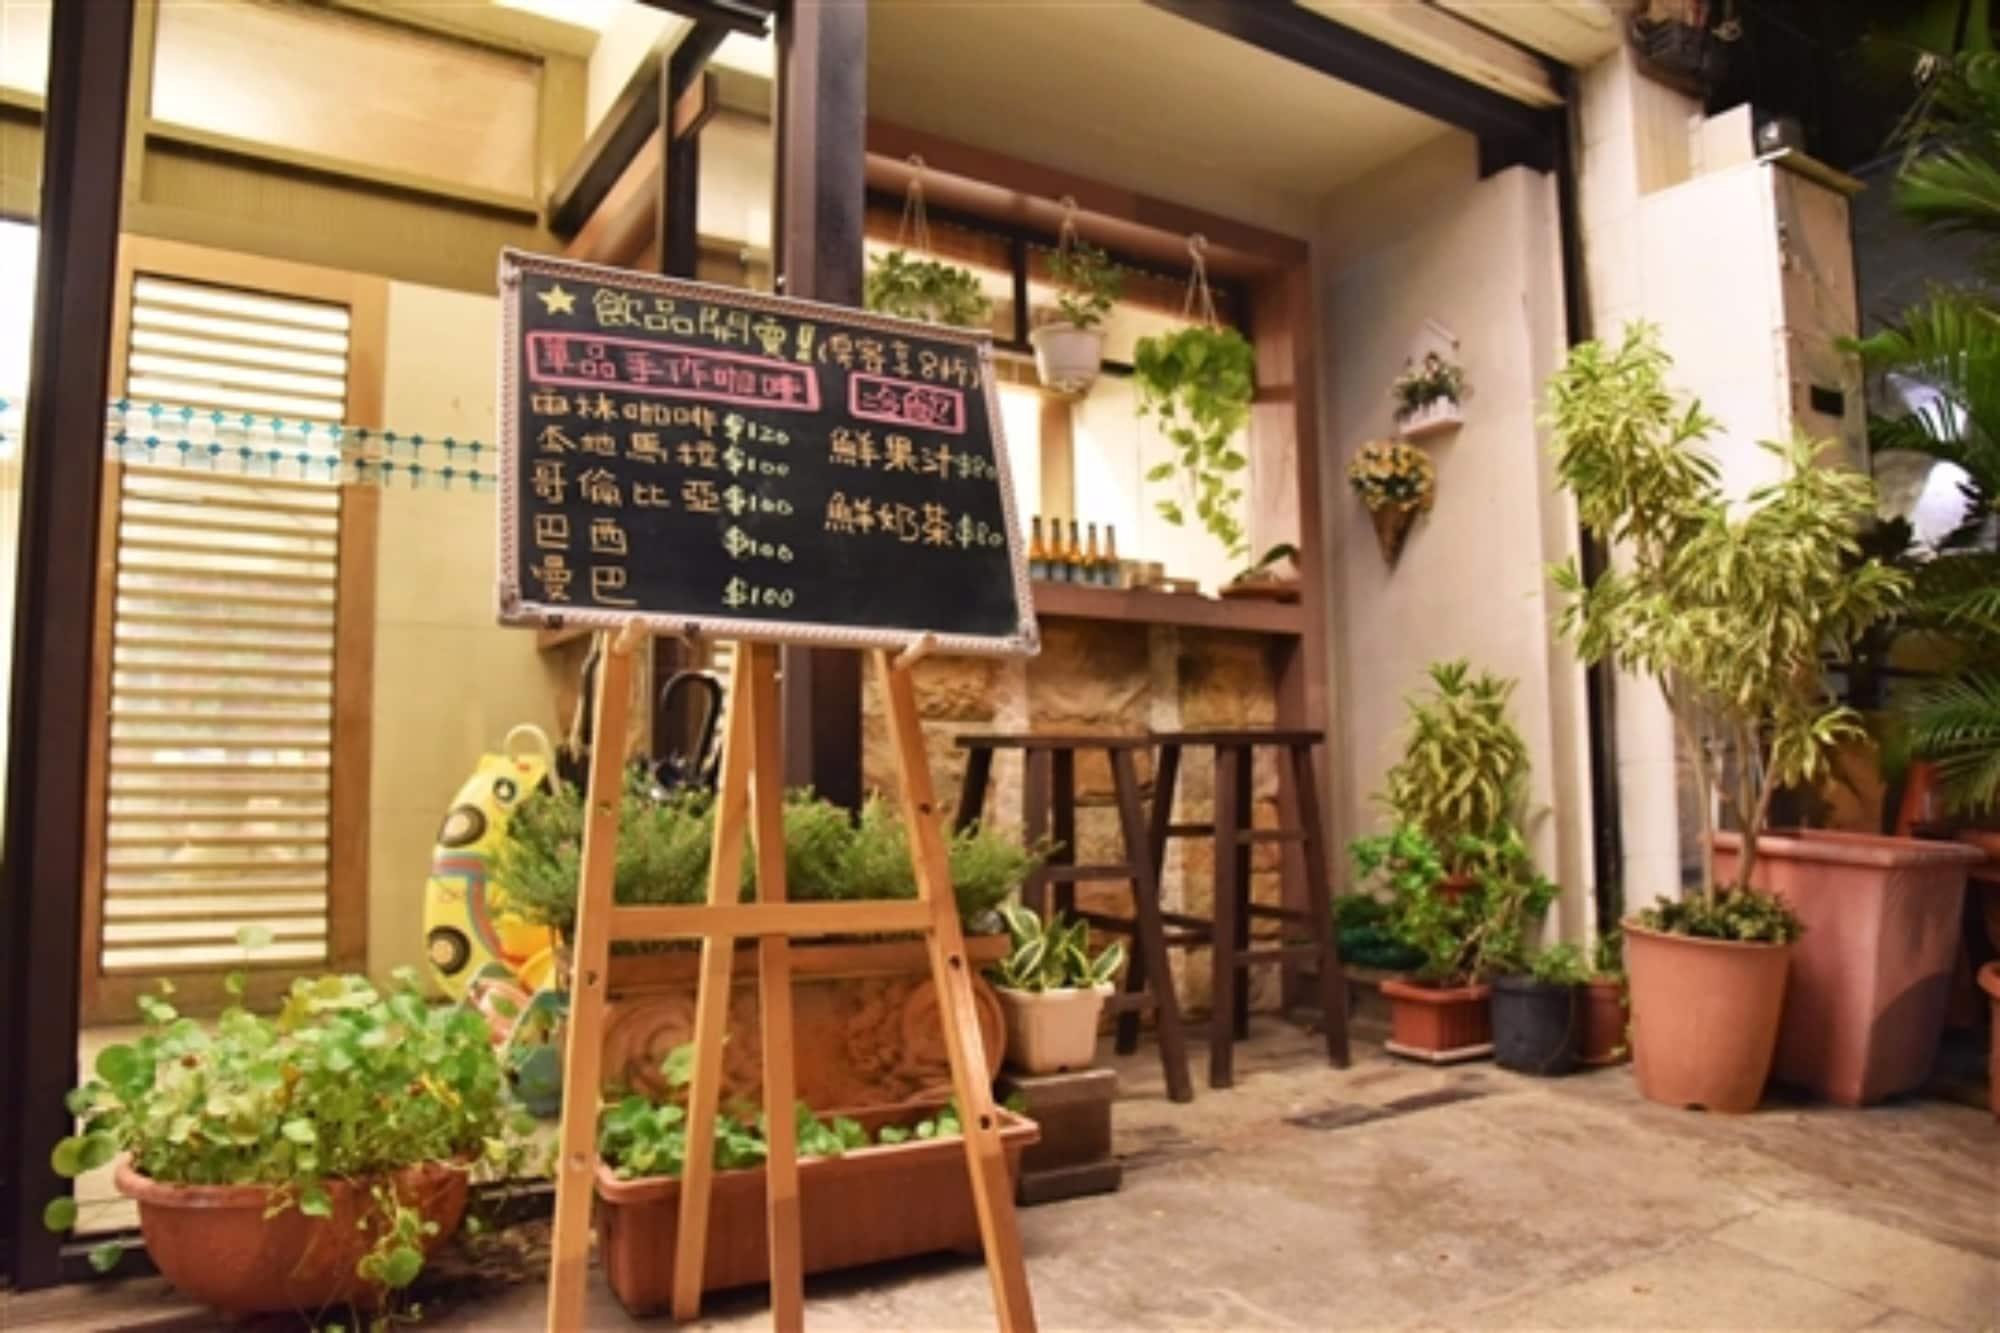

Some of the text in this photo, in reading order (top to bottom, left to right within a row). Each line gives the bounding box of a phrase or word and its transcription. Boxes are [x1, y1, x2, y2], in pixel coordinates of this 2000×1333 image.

[722, 444, 791, 477] $100
[829, 425, 953, 480] 鮮果汁
[530, 458, 795, 517] 哥倫比亞 $100
[534, 512, 795, 563] 巴西 $100
[823, 491, 953, 545] 鮮奶茶
[529, 554, 796, 608] 曼巴 $100
